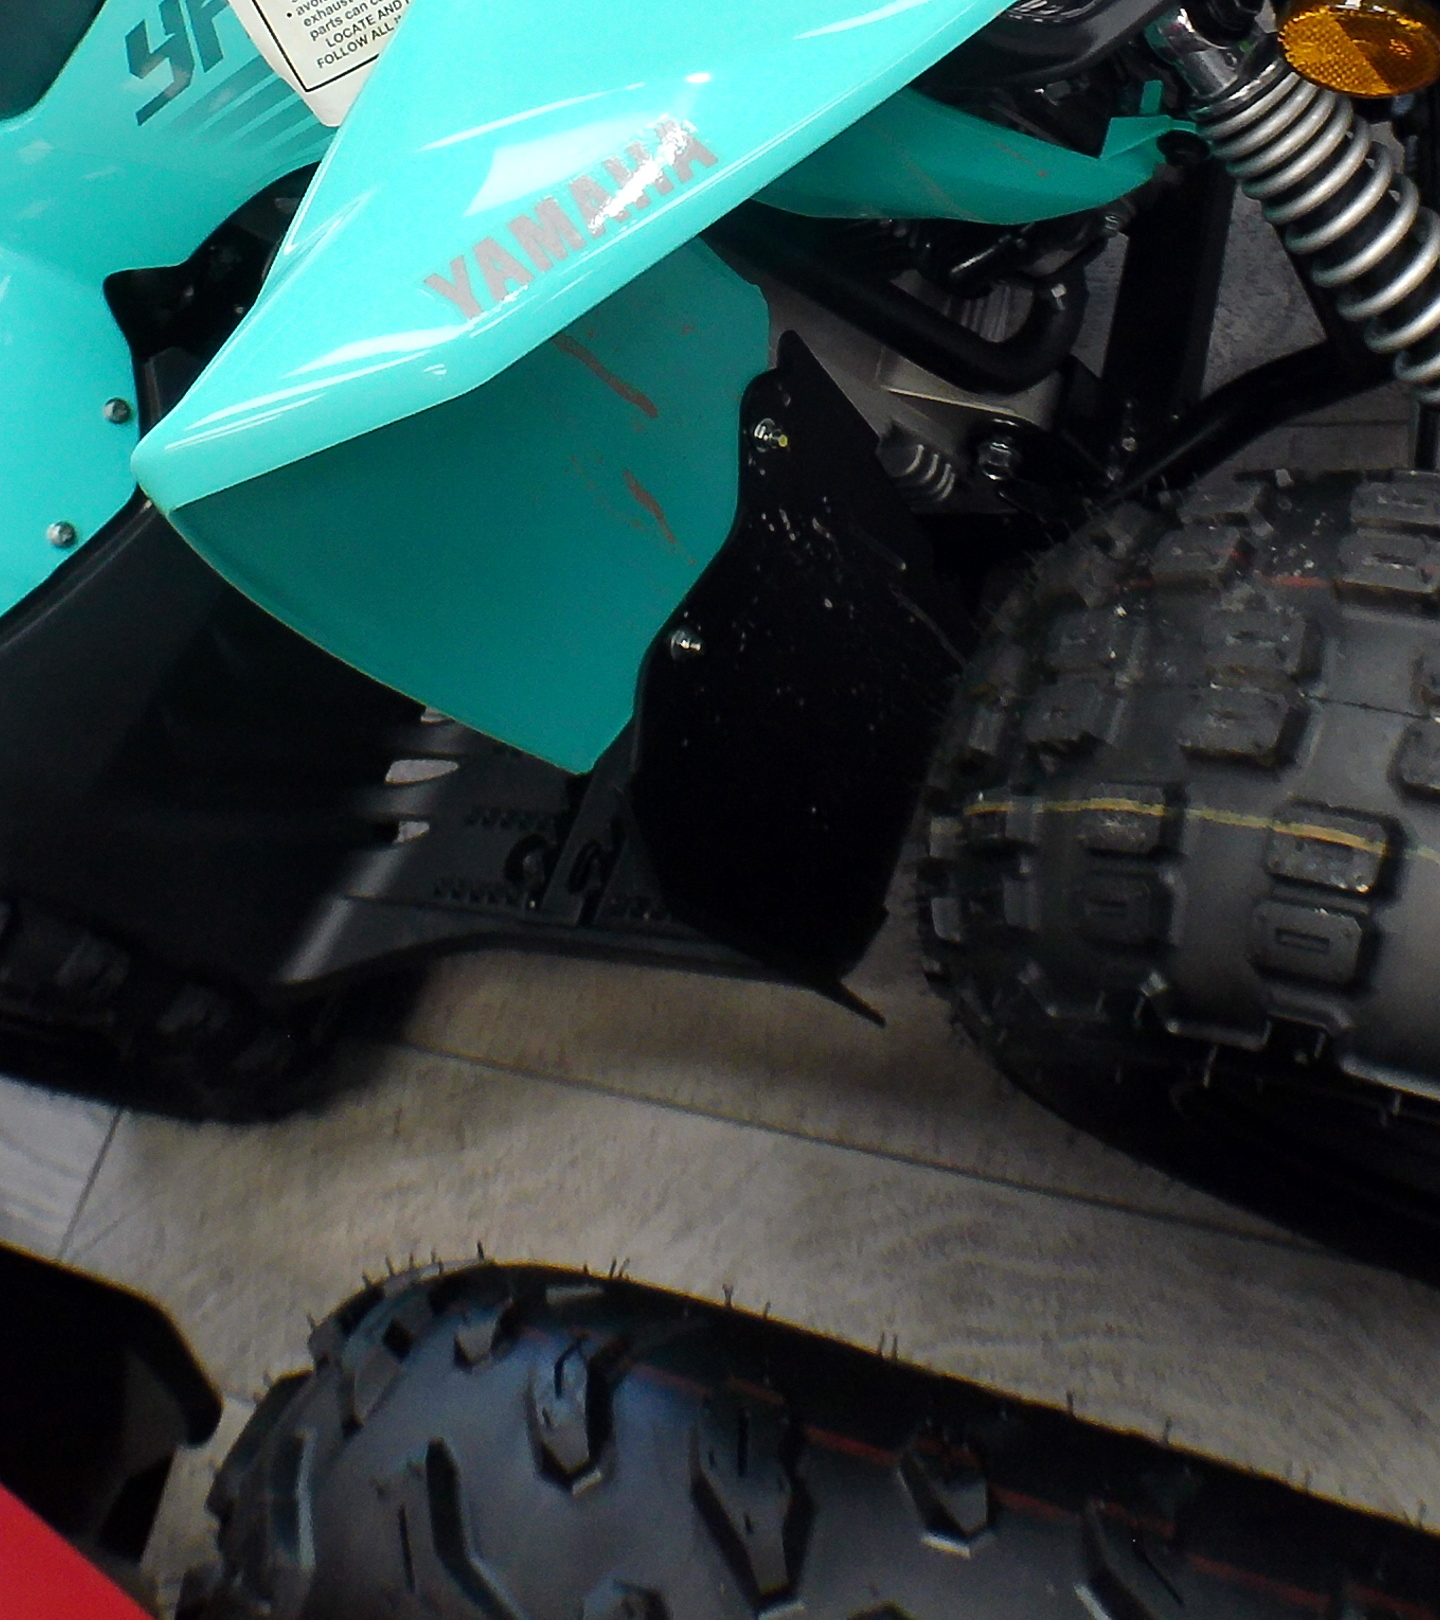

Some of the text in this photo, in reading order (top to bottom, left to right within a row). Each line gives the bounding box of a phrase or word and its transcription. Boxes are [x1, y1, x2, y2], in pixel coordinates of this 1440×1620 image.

[309, 16, 343, 41] parts
[344, 1, 368, 20] can
[316, 21, 394, 68] FOLLOW ALL
[324, 0, 402, 47] LOCATE AND
[423, 119, 719, 320] YAMAHA
